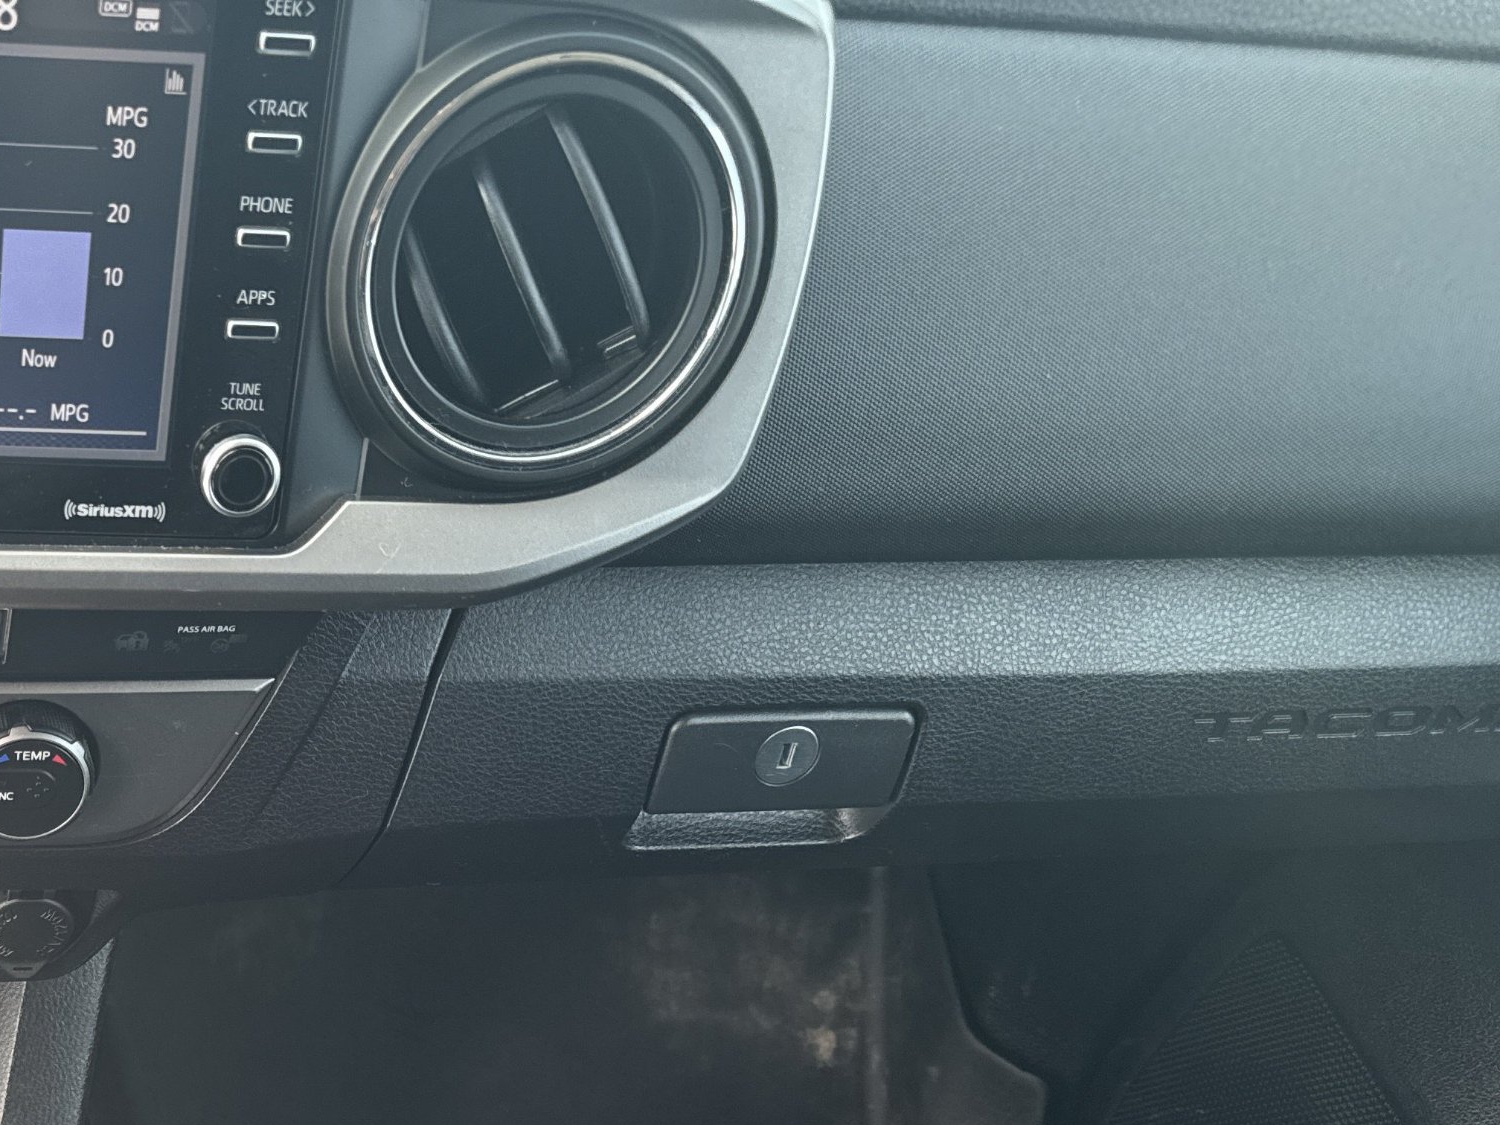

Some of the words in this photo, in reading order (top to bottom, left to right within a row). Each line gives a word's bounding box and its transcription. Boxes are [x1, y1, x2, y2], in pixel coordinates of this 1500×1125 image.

[134, 20, 160, 32] DCM
[105, 106, 148, 128] MPG
[111, 138, 136, 159] 30
[106, 203, 131, 224] 20
[239, 196, 293, 214] PHONE
[103, 267, 124, 287] 10
[236, 290, 276, 306] APPS
[101, 329, 114, 349] 0
[21, 348, 57, 369] Now
[229, 382, 262, 396] TUNE
[50, 403, 90, 424] MPG
[220, 397, 265, 412] SCROLL
[177, 625, 200, 634] PASS
[200, 625, 216, 633] AIR
[216, 624, 237, 633] BAG
[1193, 707, 1500, 742] TACOM
[14, 750, 51, 761] TEMP
